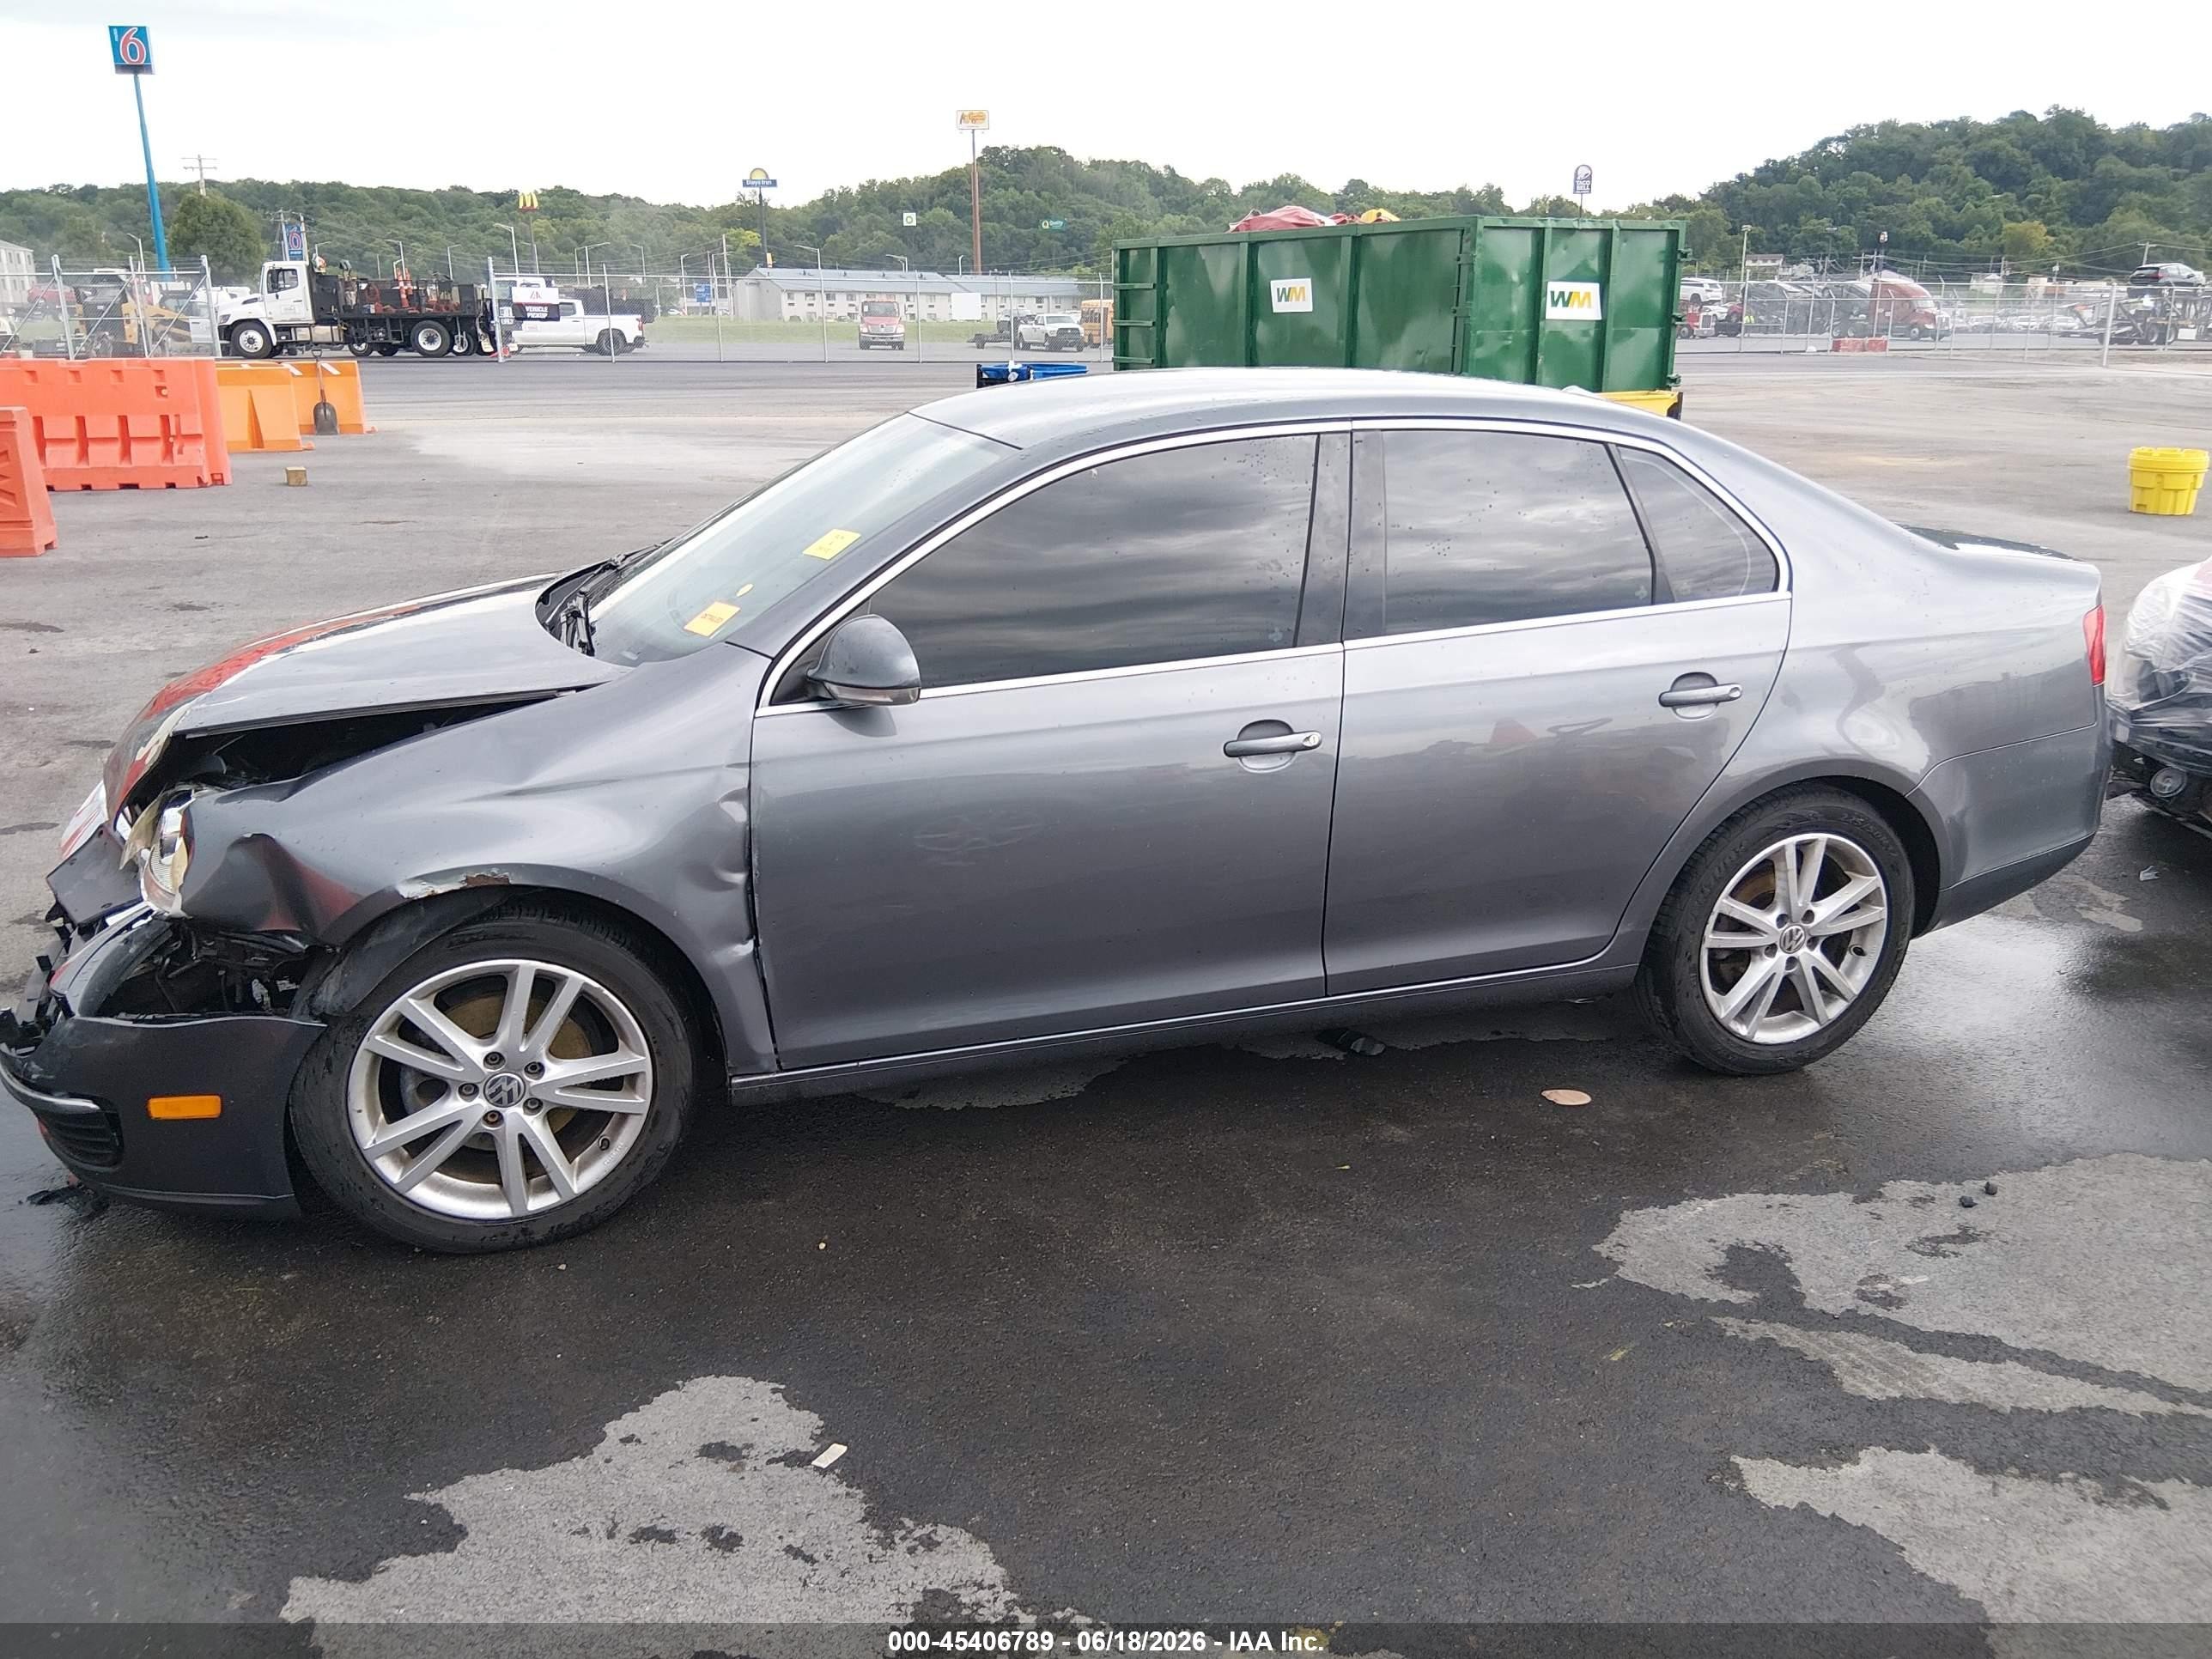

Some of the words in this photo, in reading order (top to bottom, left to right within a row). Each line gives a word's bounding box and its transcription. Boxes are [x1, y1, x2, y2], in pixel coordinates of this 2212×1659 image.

[119, 27, 146, 64] 6
[1276, 287, 1306, 303] WM
[1550, 290, 1592, 308] WM
